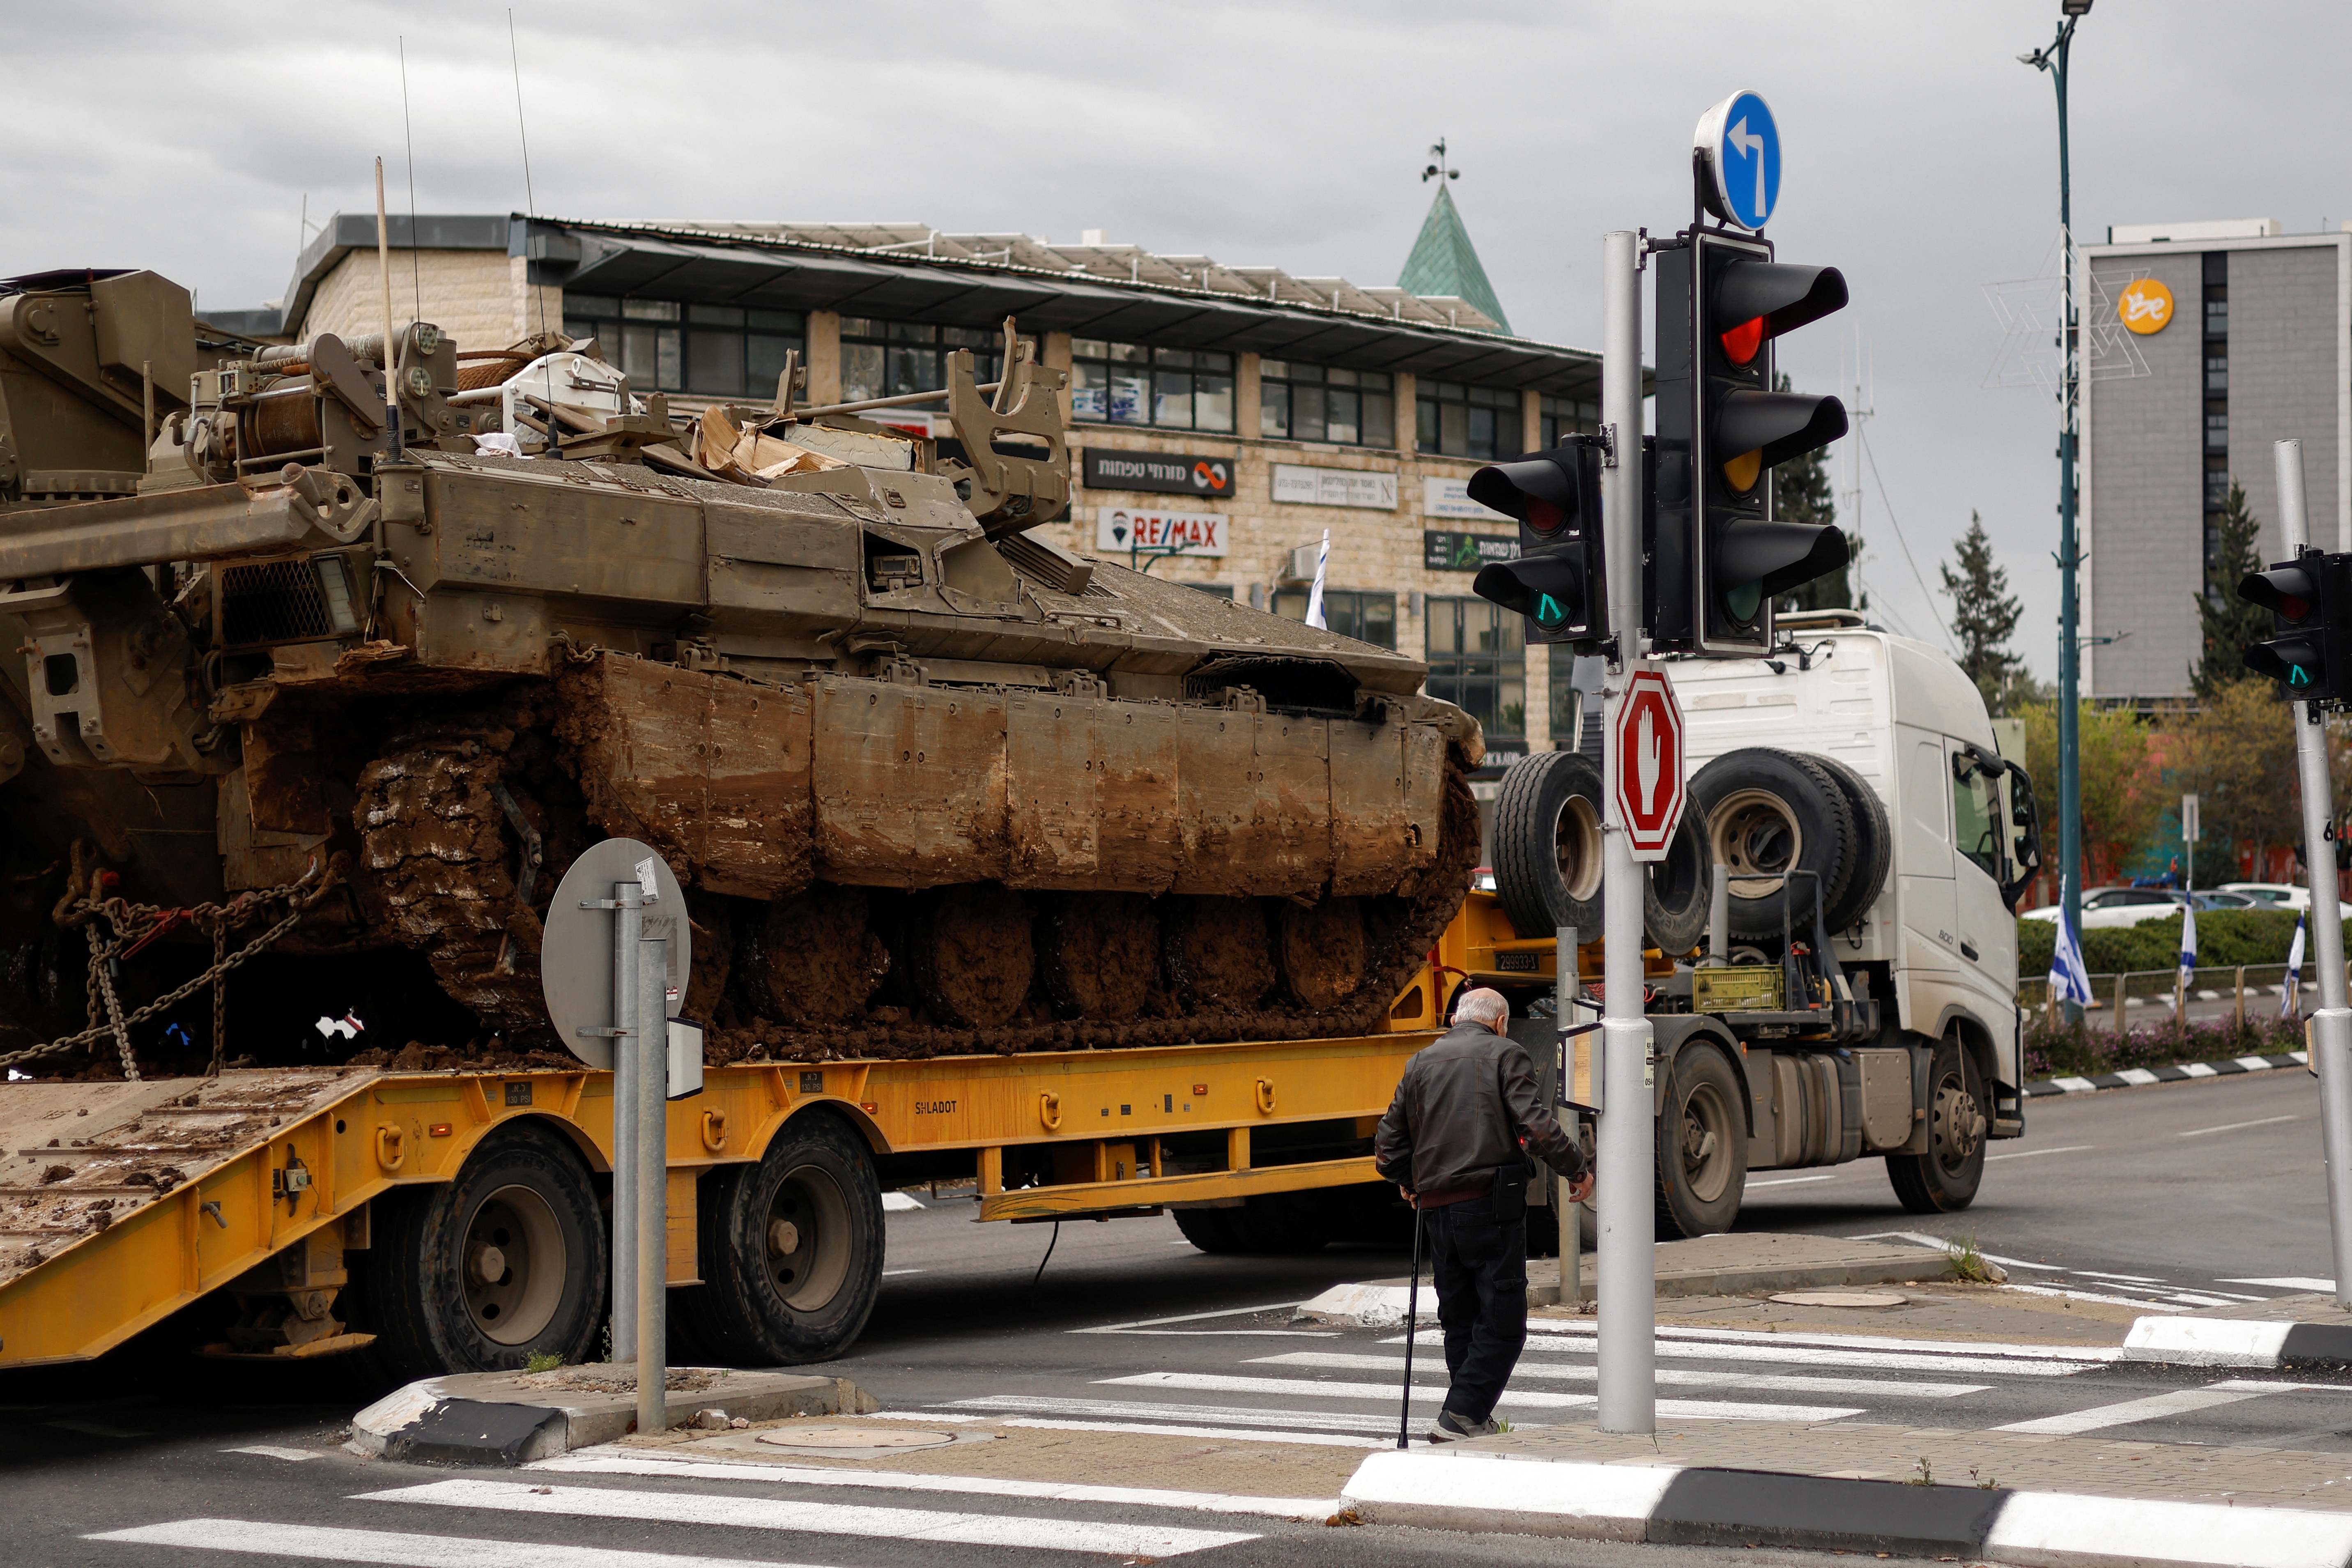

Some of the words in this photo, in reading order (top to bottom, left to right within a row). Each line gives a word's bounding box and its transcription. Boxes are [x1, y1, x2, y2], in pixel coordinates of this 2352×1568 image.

[1098, 459, 1145, 478] טפחות
[1148, 462, 1187, 481] מזרחי
[1134, 516, 1217, 548] RE/MAX
[2323, 821, 2334, 841] 6
[507, 1095, 518, 1104] 130
[520, 1095, 531, 1103] PSI
[915, 1100, 957, 1115] SHLADOT
